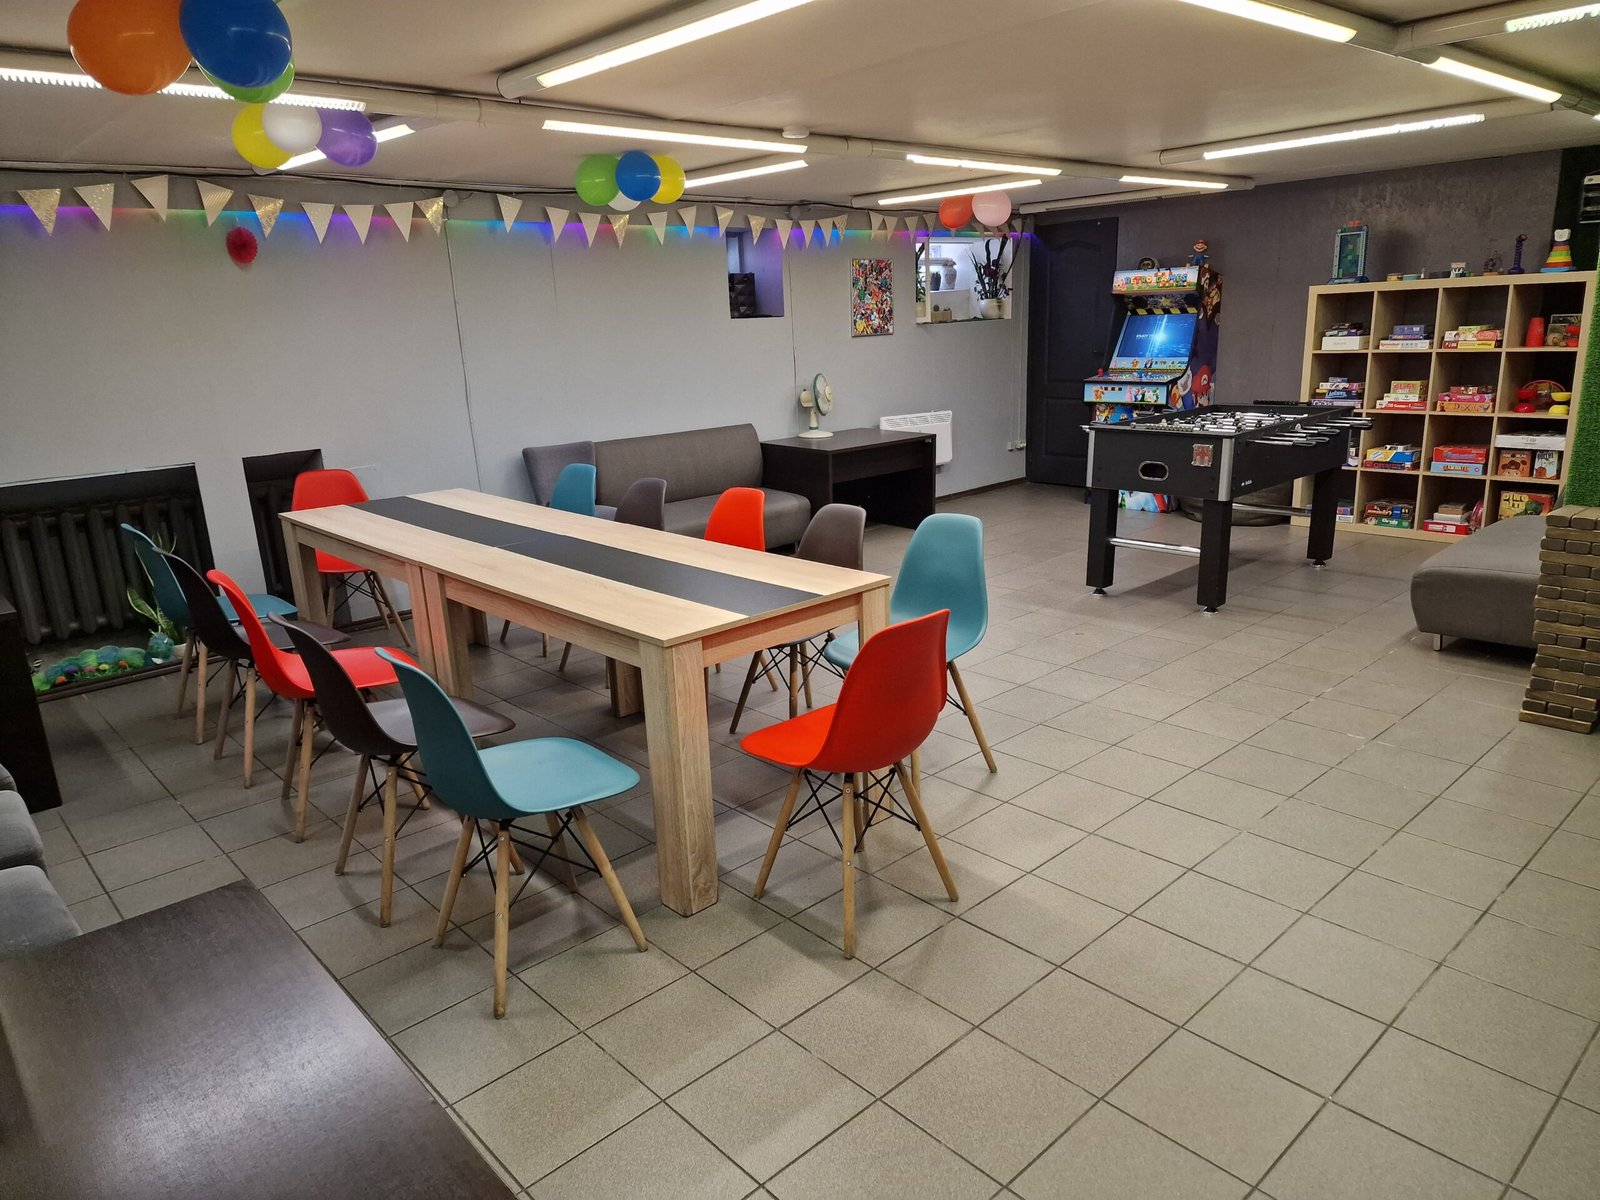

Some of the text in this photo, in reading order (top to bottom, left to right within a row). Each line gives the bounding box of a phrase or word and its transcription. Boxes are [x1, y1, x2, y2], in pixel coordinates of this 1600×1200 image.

[1124, 273, 1187, 284] RETRO GAMES
[1503, 493, 1528, 502] DINO
